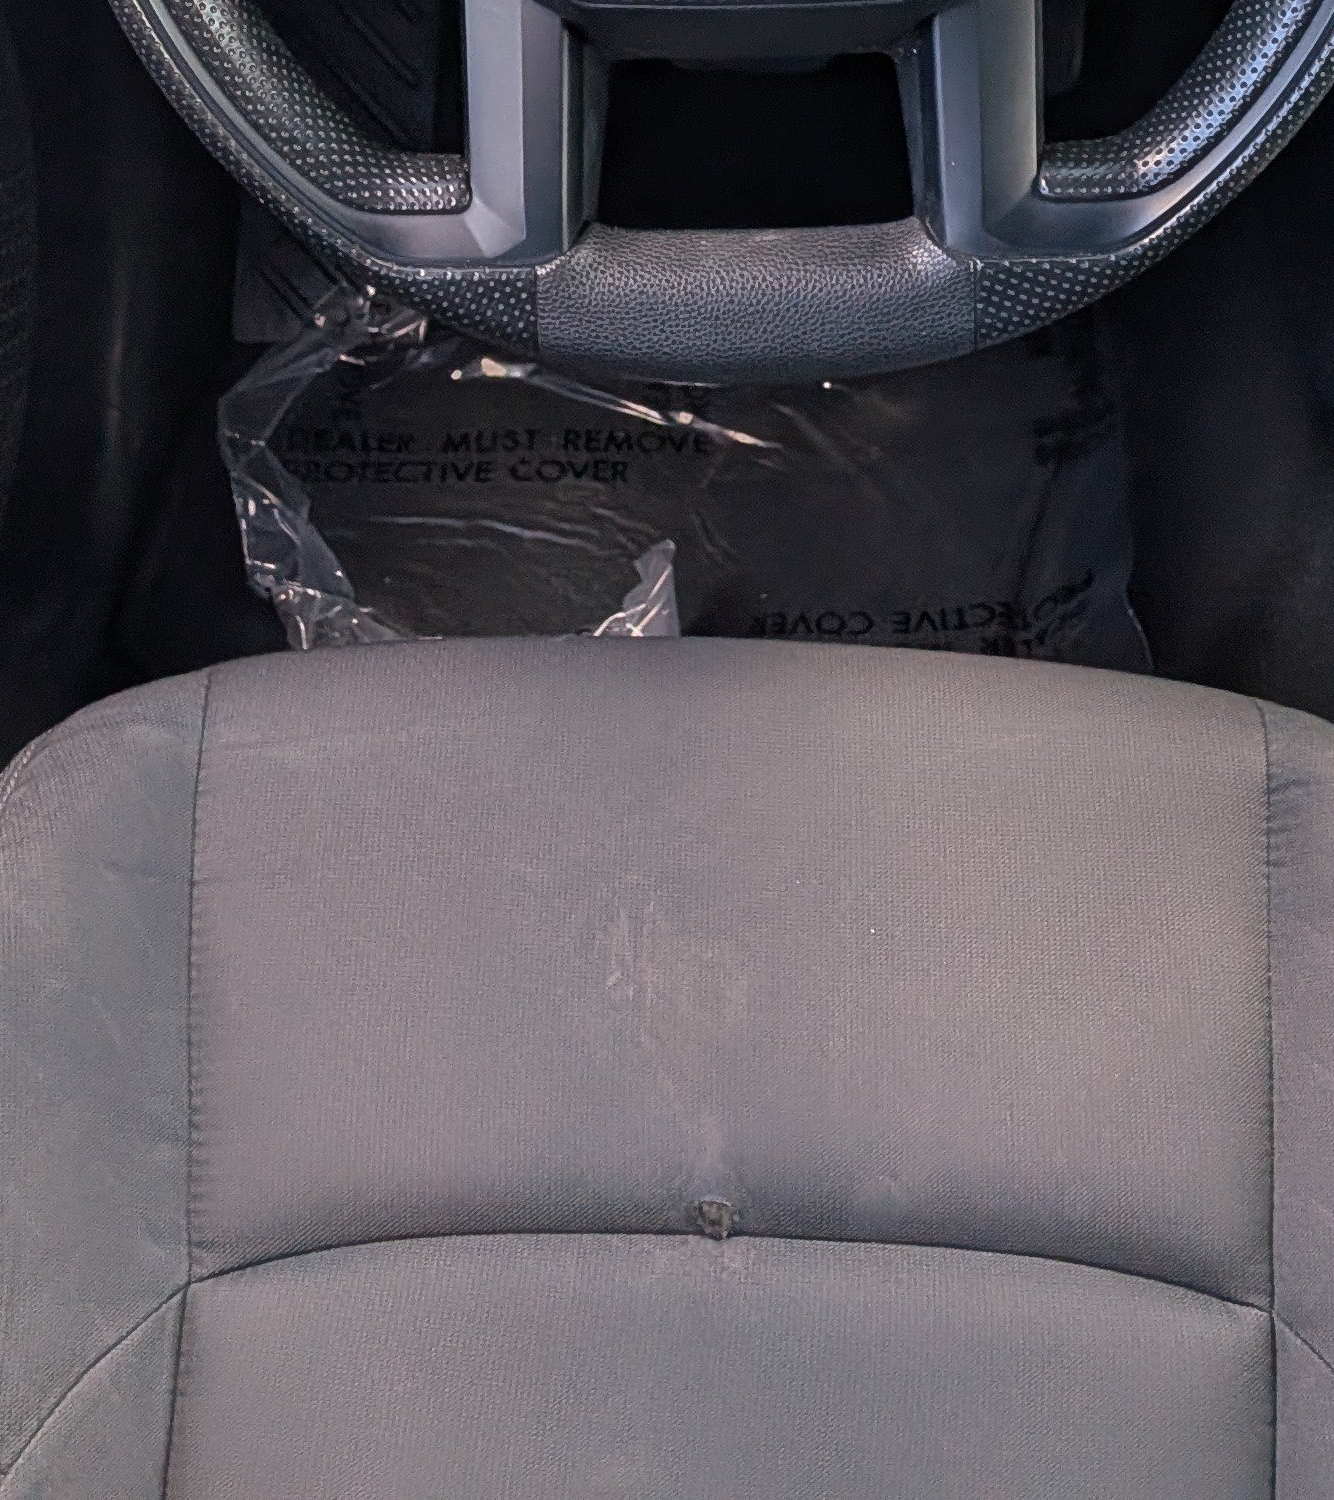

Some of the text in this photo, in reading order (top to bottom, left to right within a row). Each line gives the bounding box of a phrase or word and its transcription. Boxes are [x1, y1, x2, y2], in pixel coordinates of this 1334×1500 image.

[441, 429, 537, 454] MUST
[559, 430, 711, 456] REMOVE
[281, 458, 630, 484] PROTECTIVE COVER
